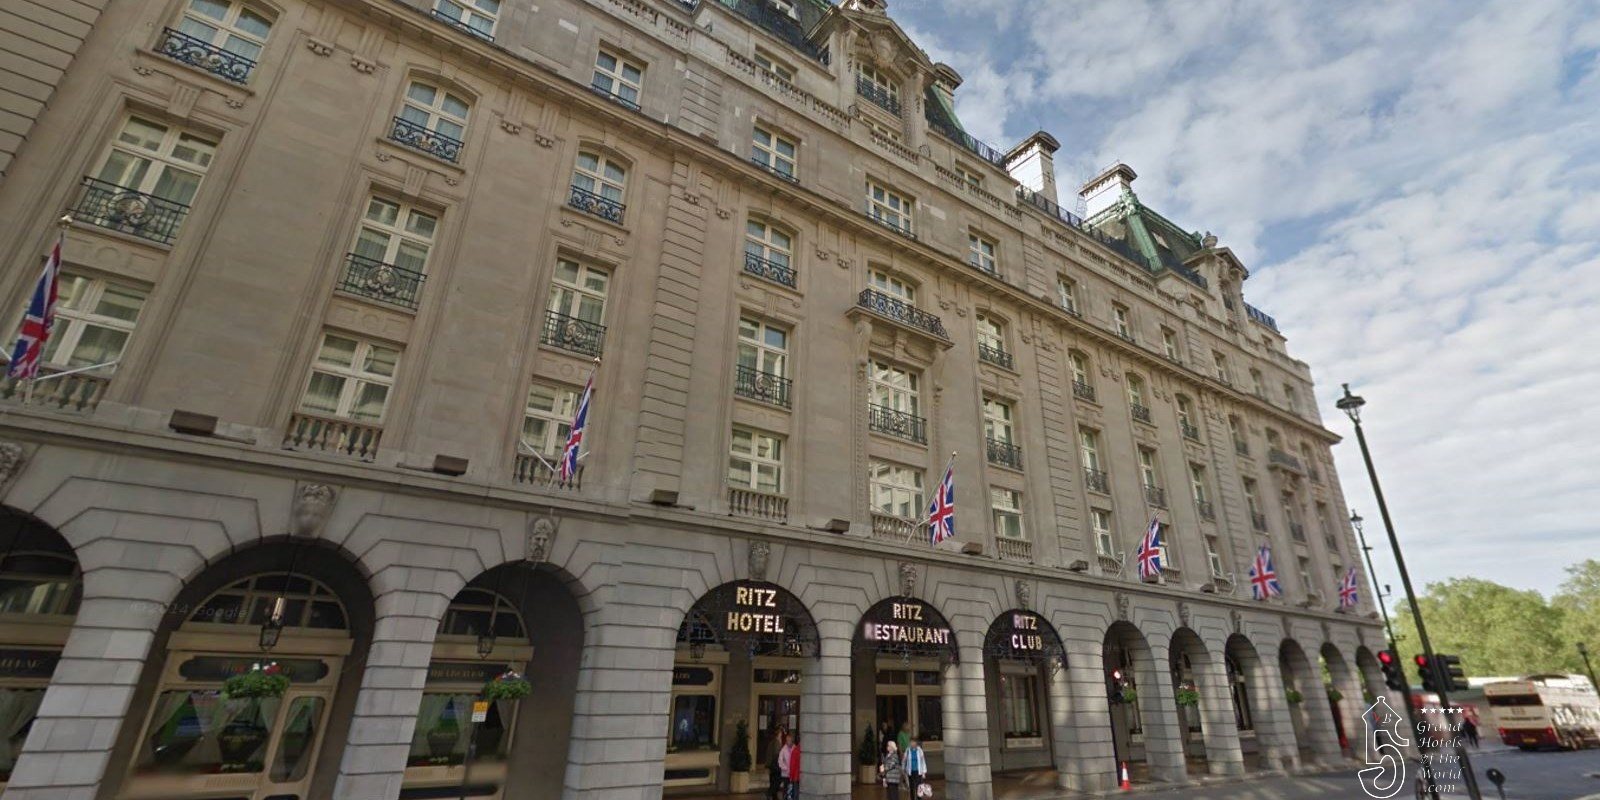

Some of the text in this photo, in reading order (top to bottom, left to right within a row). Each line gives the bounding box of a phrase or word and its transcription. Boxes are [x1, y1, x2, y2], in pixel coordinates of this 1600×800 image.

[736, 586, 776, 607] RITZ
[893, 603, 922, 620] RITZ
[727, 611, 784, 632] HOTEL
[1013, 614, 1037, 630] RITZ
[1012, 634, 1042, 650] CLUB
